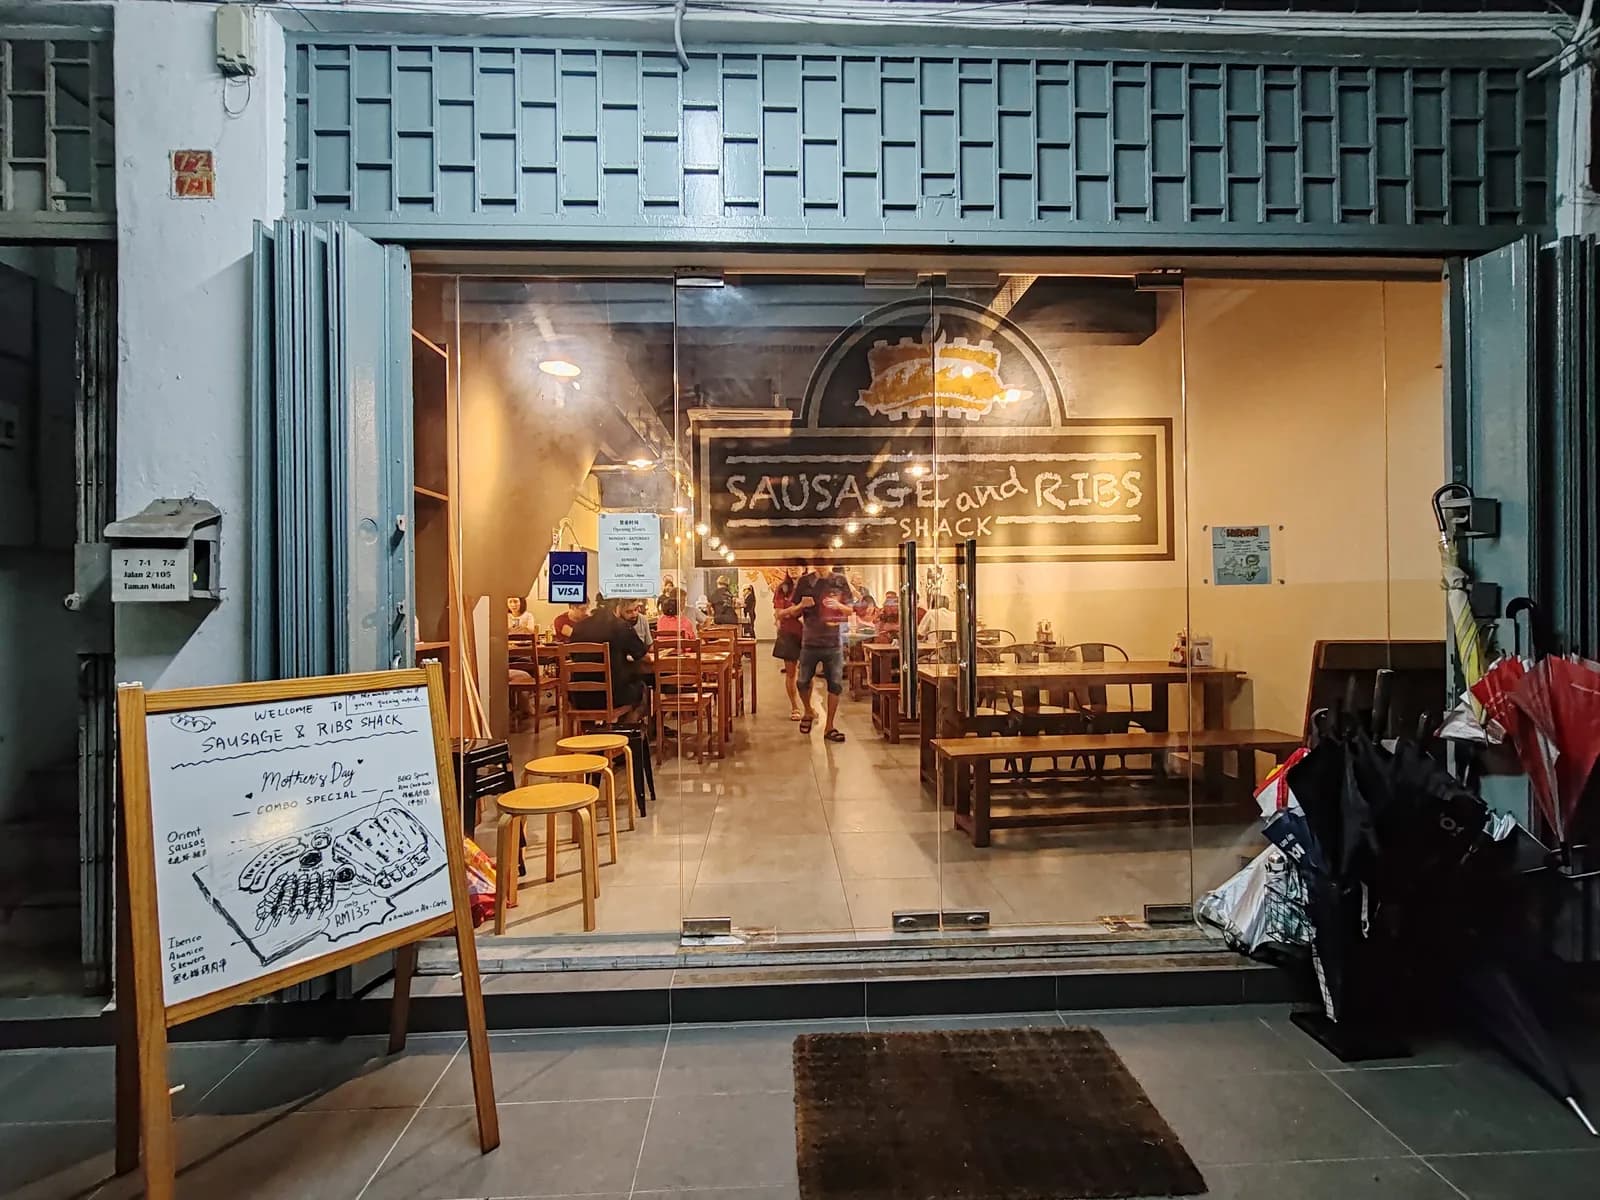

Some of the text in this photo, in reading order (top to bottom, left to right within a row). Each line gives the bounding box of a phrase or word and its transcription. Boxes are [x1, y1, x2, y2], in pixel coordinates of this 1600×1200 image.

[725, 465, 1142, 513] SAUSAGE and RIBS
[899, 515, 993, 538] SHACK
[551, 564, 585, 576] OPEN
[557, 587, 580, 596] VISA
[254, 701, 342, 721] WELCOME TO
[202, 713, 403, 753] SAUSAGE & RIBS SHACK
[330, 761, 356, 787] Day
[256, 790, 358, 815] COMBO SPECIAL
